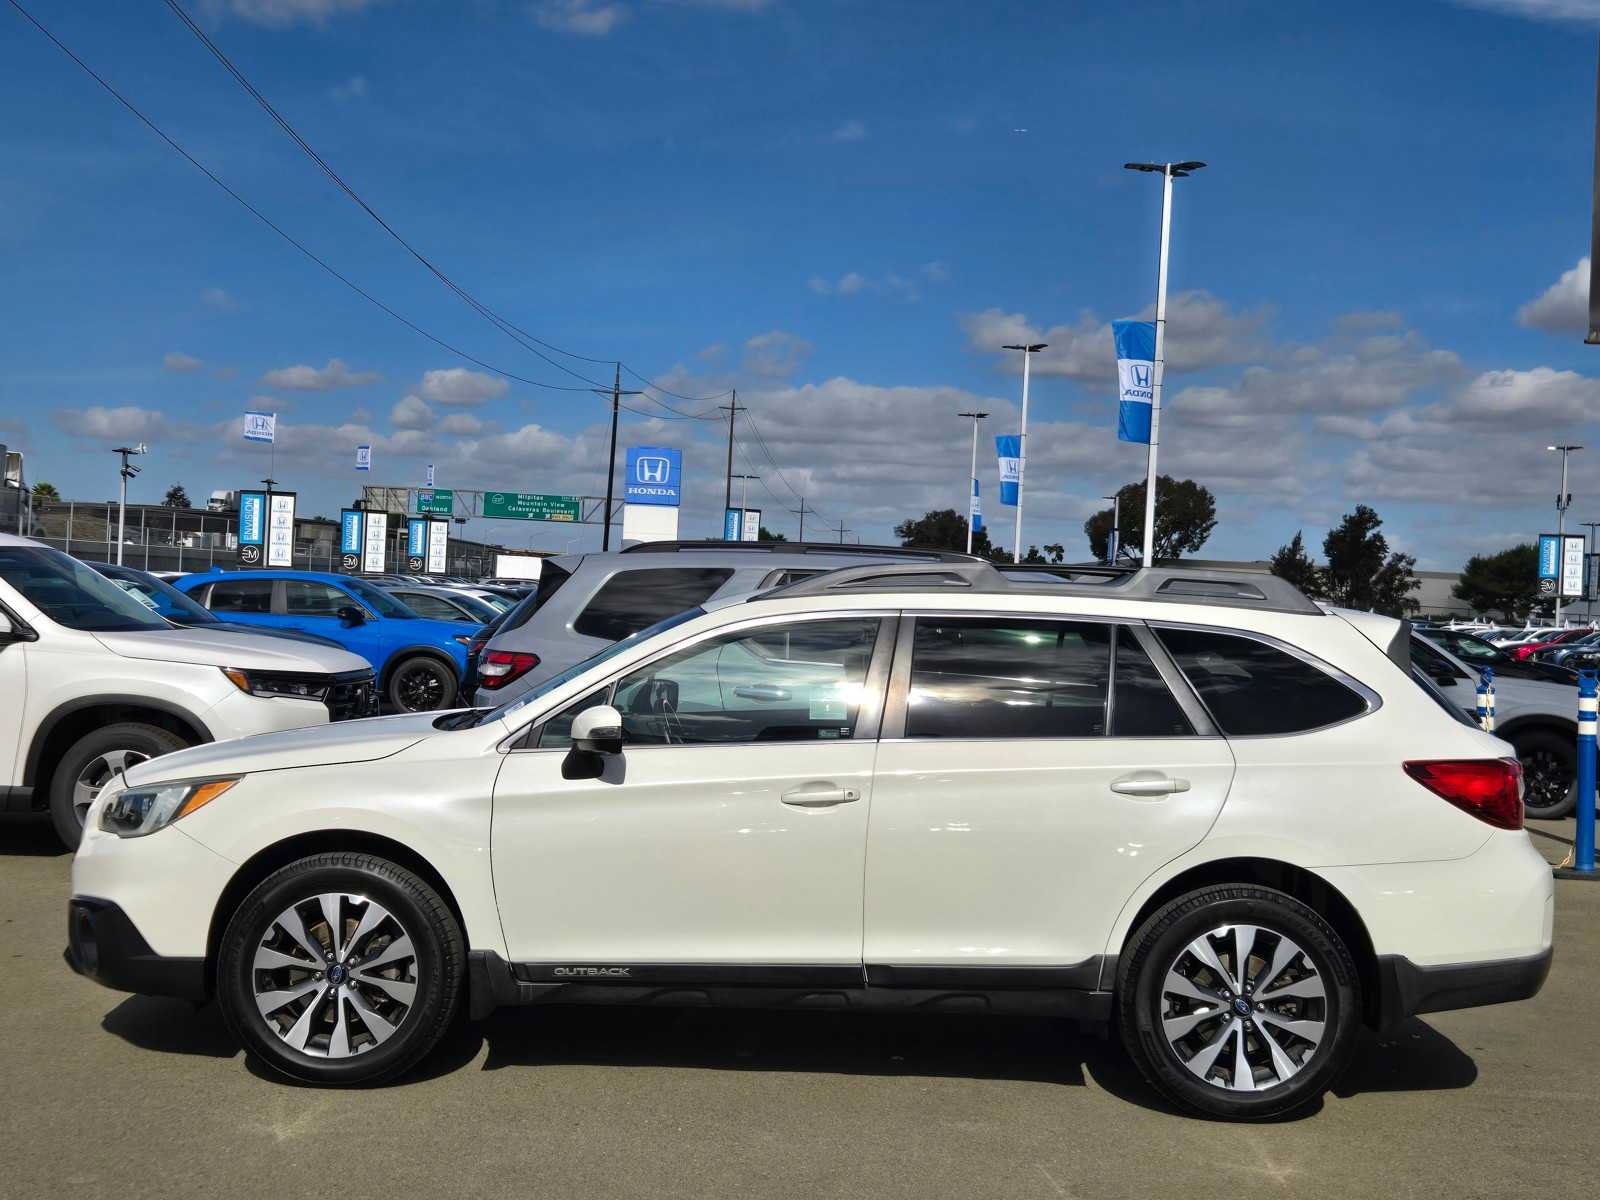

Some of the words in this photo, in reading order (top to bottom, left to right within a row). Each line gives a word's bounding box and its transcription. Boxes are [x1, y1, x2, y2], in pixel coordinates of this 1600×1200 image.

[628, 487, 676, 496] HONDA
[507, 505, 540, 513] Calaveras
[542, 507, 575, 515] Boulevard
[243, 496, 254, 541] ENVISION
[554, 967, 630, 976] OUTBACK
